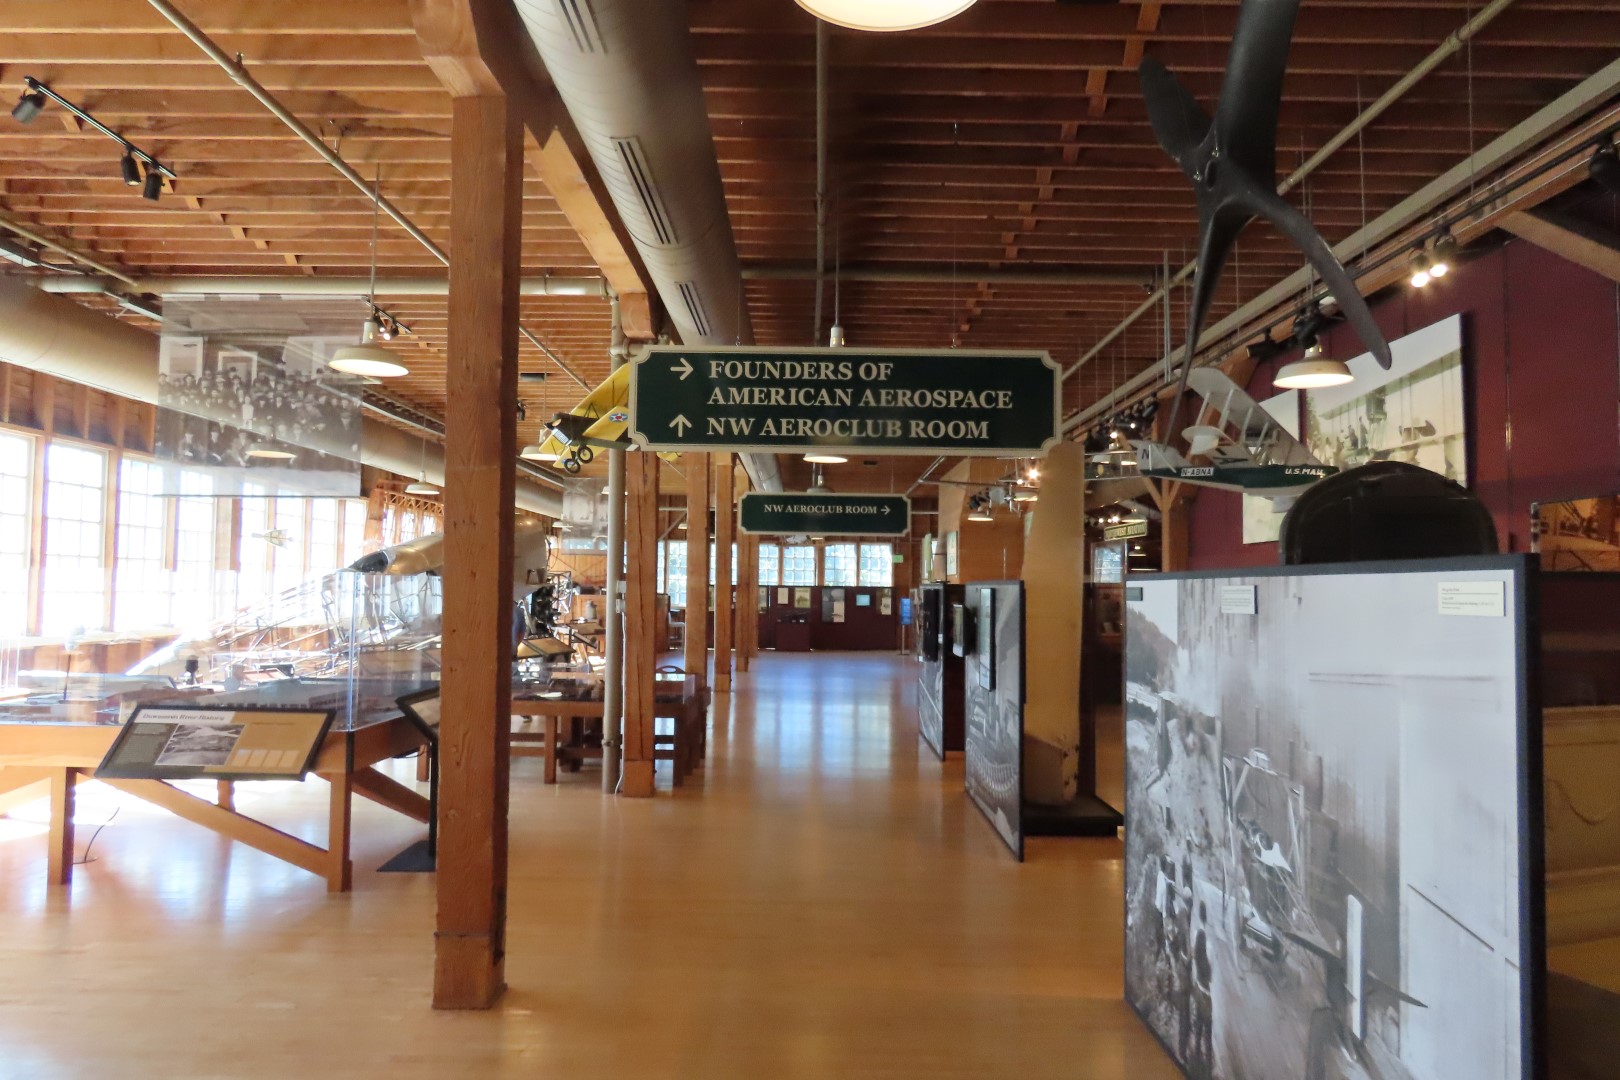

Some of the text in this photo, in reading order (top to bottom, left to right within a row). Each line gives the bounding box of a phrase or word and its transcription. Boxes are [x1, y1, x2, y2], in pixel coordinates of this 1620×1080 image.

[708, 360, 894, 381] FOUNDERS OF
[706, 386, 1013, 409] AMERICAN AEROSPACE
[706, 417, 989, 439] NW AEROCLUB ROOM
[763, 504, 877, 514] NW AEROCLUB ROOM
